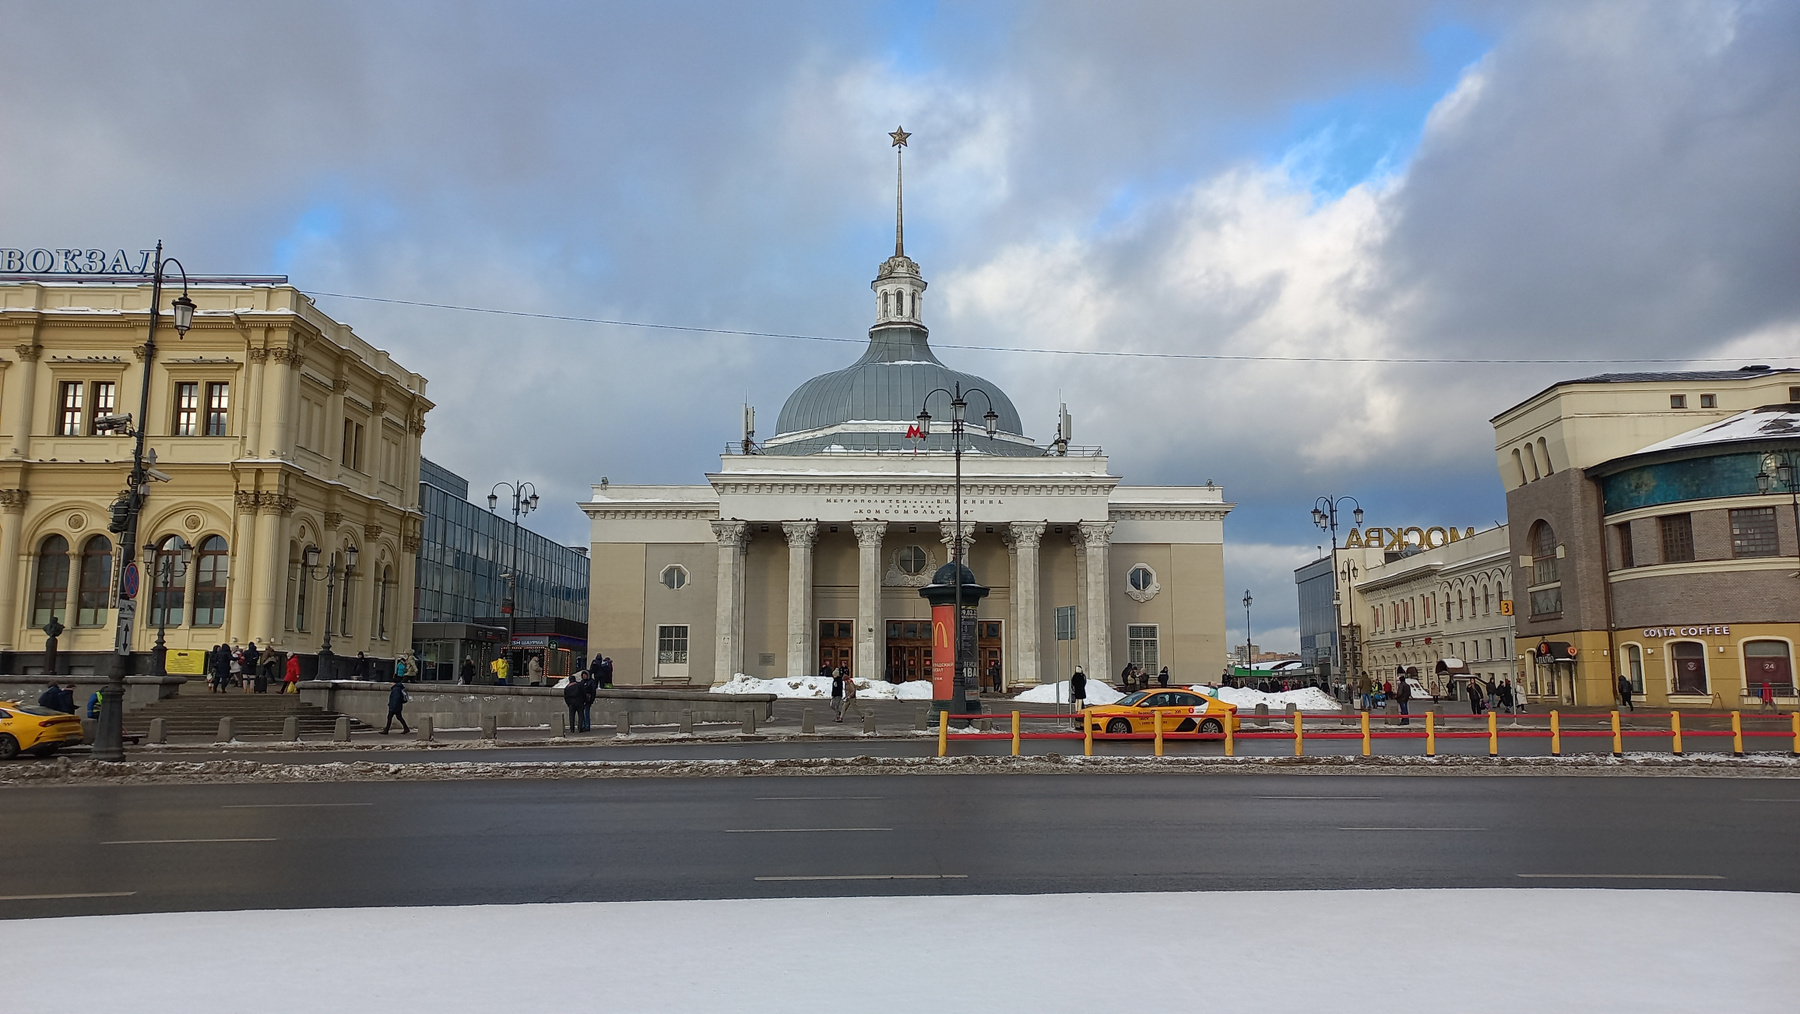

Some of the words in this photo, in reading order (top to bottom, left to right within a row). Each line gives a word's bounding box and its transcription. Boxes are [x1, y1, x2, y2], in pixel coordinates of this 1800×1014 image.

[0, 248, 160, 274] ВОКЗАЛ
[1643, 628, 1676, 638] COSTA
[1680, 625, 1730, 637] COFFEE
